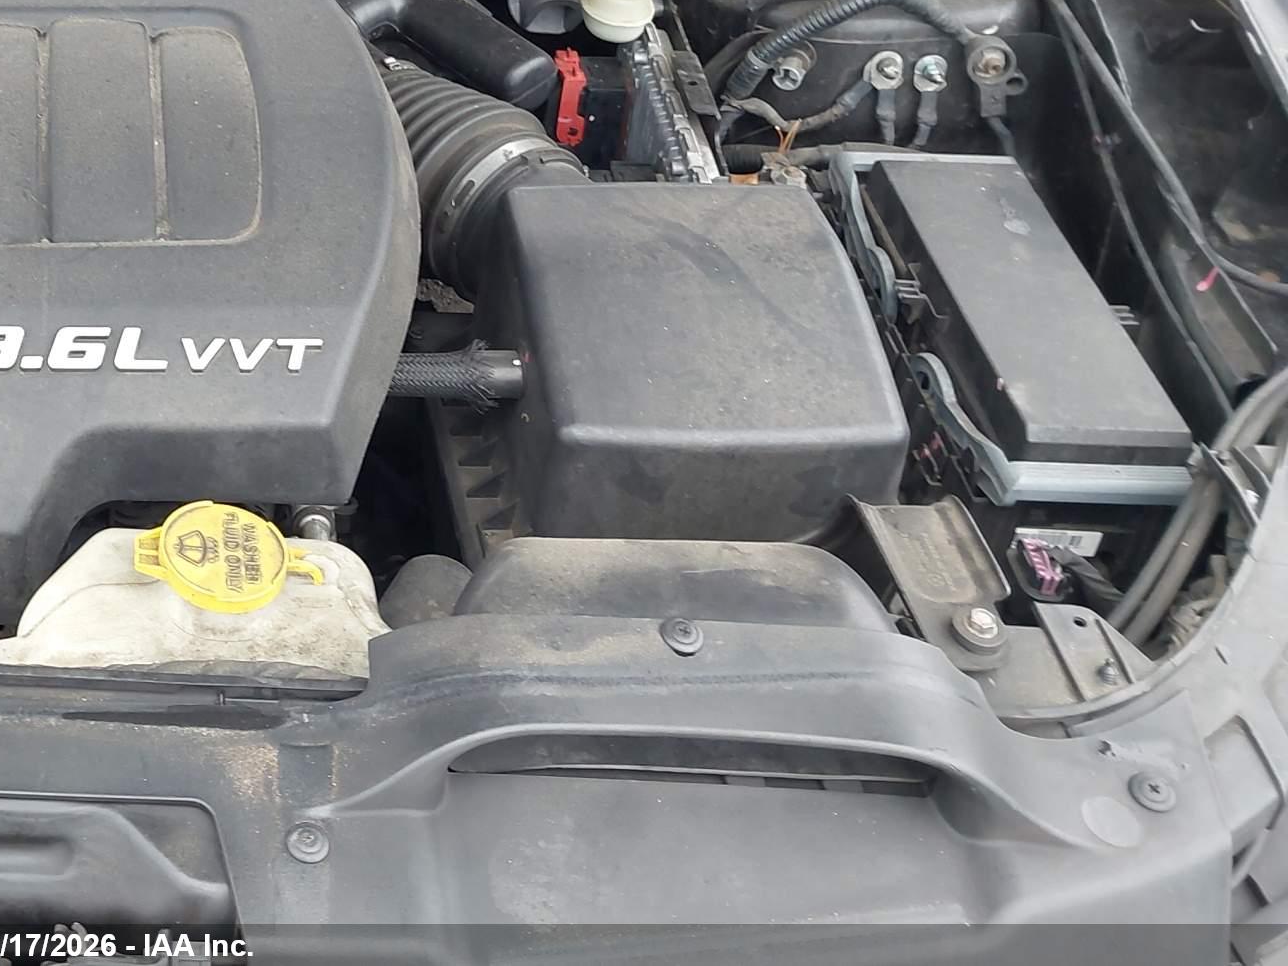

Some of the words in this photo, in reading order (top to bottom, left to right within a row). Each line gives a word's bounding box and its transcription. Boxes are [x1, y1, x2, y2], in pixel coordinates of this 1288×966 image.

[180, 337, 325, 373] VVT
[222, 512, 240, 552] FLUID
[242, 523, 261, 584] WASHER
[225, 554, 242, 593] ONLY
